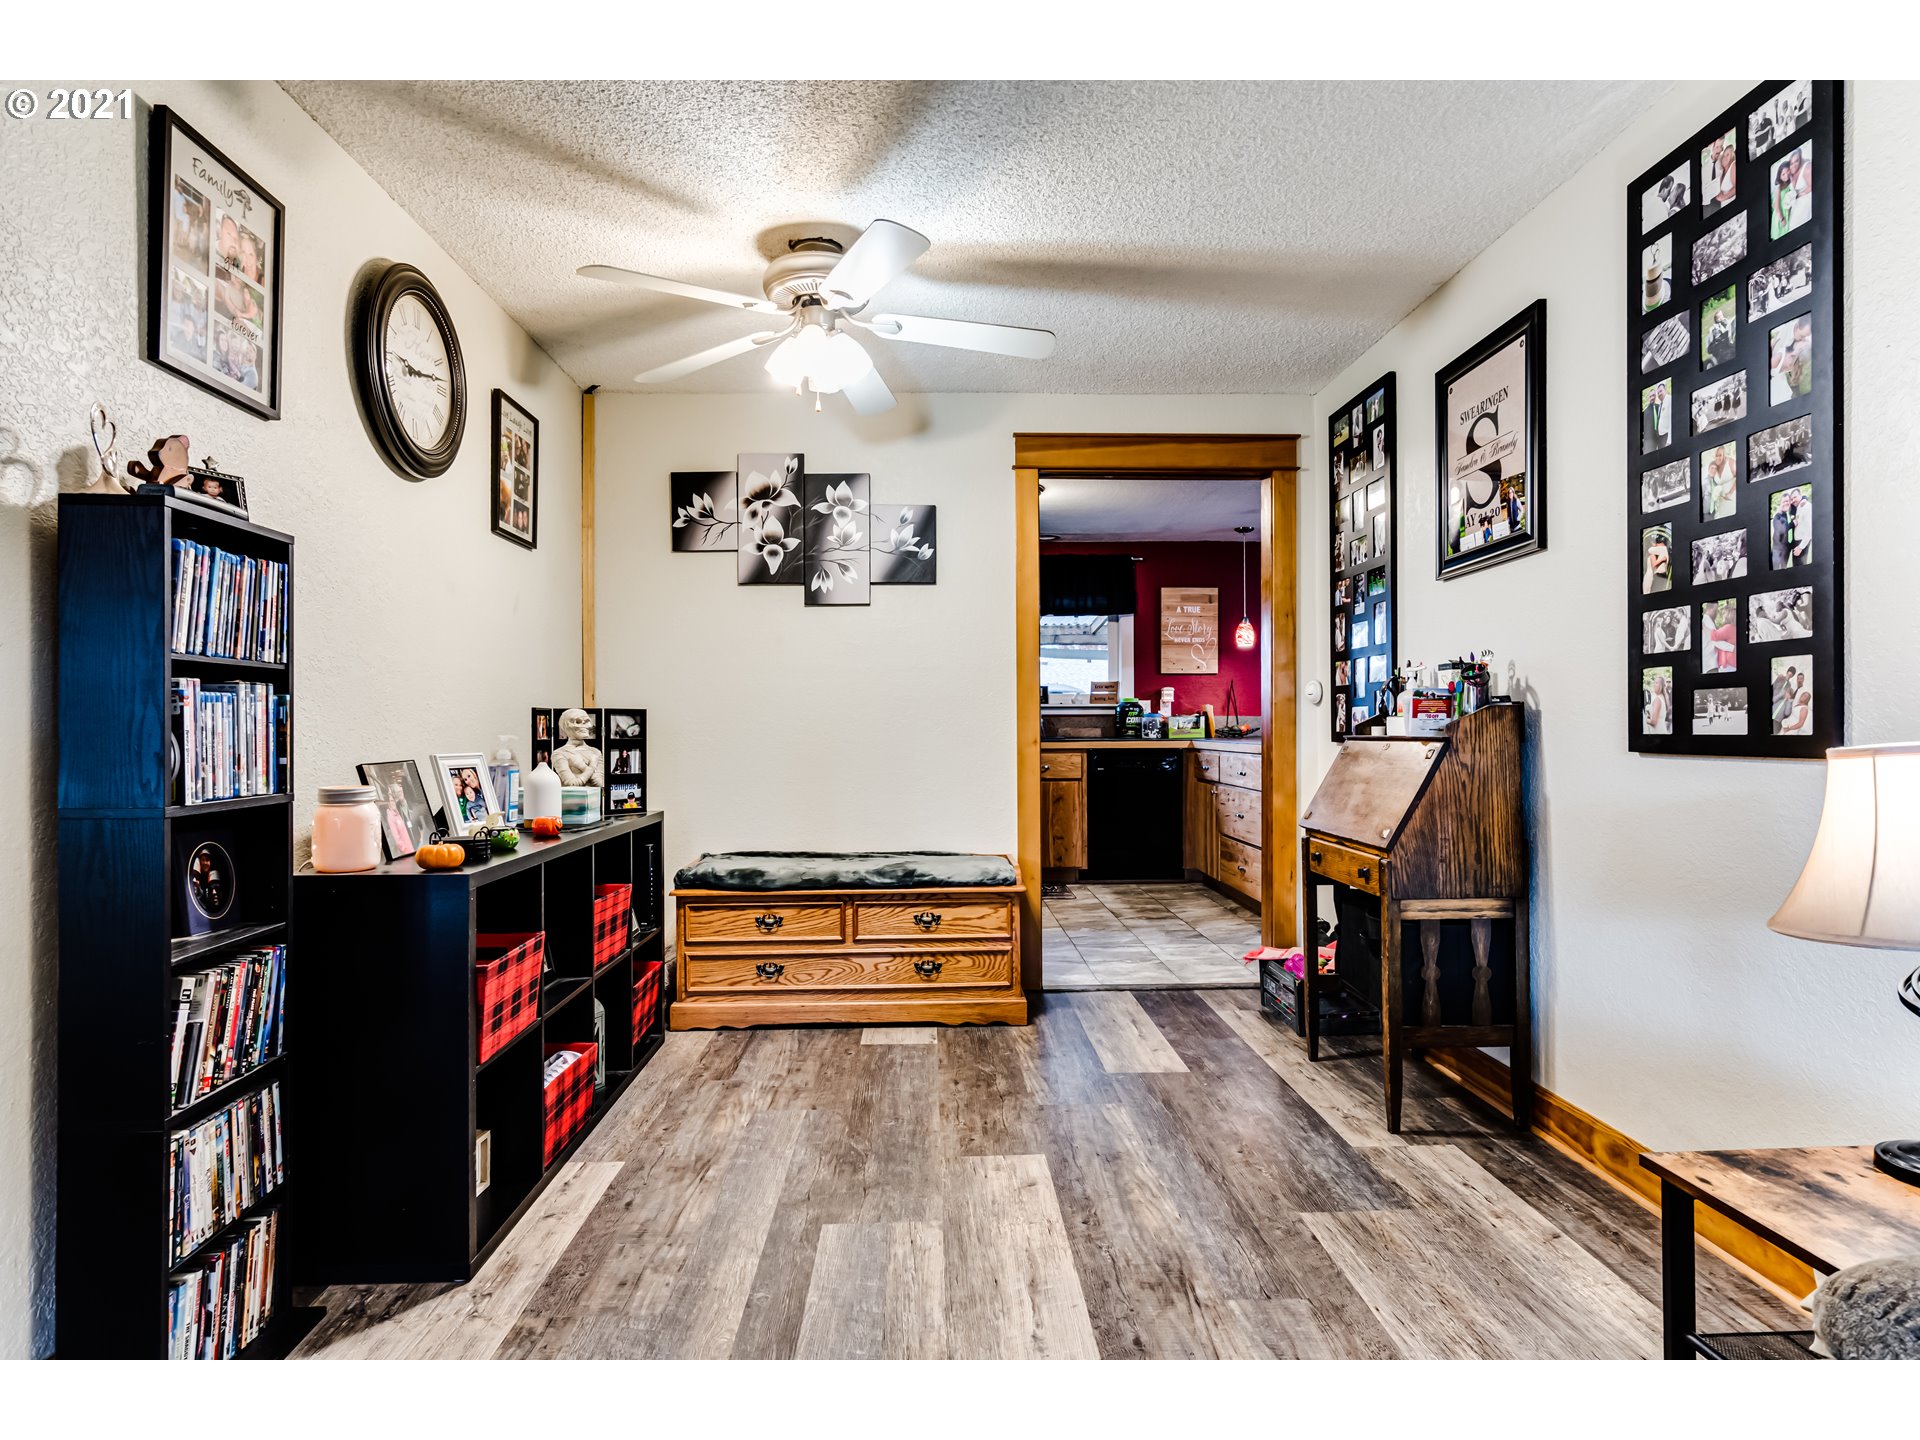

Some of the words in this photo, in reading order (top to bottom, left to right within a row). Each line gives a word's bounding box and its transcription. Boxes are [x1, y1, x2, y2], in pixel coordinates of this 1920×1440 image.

[192, 157, 234, 207] Family
[232, 316, 259, 342] forever
[1459, 386, 1509, 426] SWEARINGEN
[1466, 405, 1502, 515] S
[1164, 617, 1185, 639] Love
[1188, 618, 1212, 640] Story
[228, 977, 234, 988] AM
[223, 1001, 234, 1051] GLADIATOR
[220, 1293, 228, 1333] MAMA
